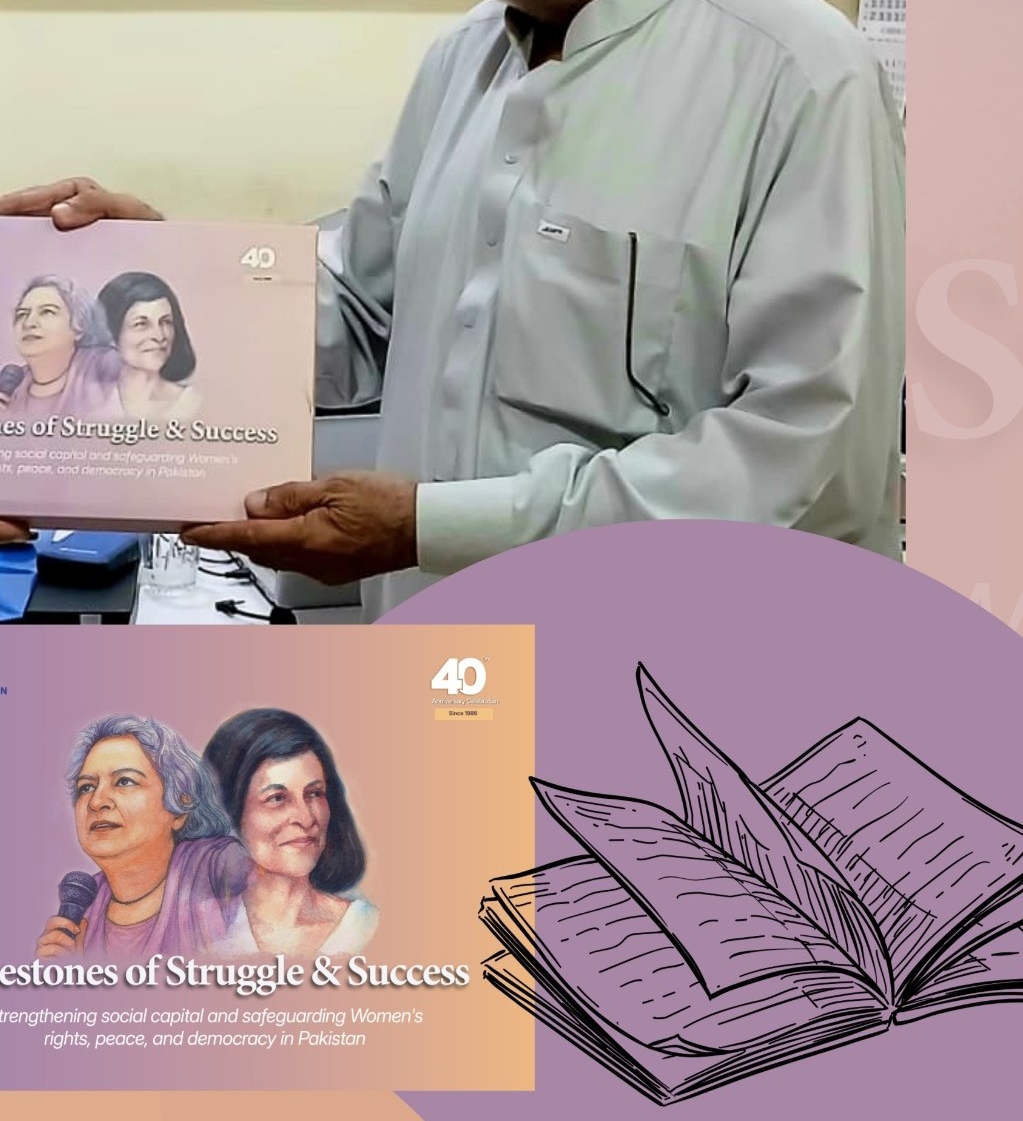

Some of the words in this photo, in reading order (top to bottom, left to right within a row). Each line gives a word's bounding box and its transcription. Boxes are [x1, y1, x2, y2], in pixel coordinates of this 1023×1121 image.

[240, 247, 276, 268] 40
[31, 415, 56, 437] of
[61, 417, 160, 444] Struggle
[166, 418, 186, 440] &
[190, 420, 279, 443] Success
[14, 447, 48, 460] social
[49, 449, 88, 461] capital
[90, 450, 110, 461] and
[113, 451, 186, 465] safeguarding
[189, 452, 239, 465] Women's
[17, 465, 55, 476] peace,
[57, 464, 80, 475] and
[81, 465, 143, 478] democracy
[146, 466, 157, 477] in
[158, 467, 207, 478] Pakistan
